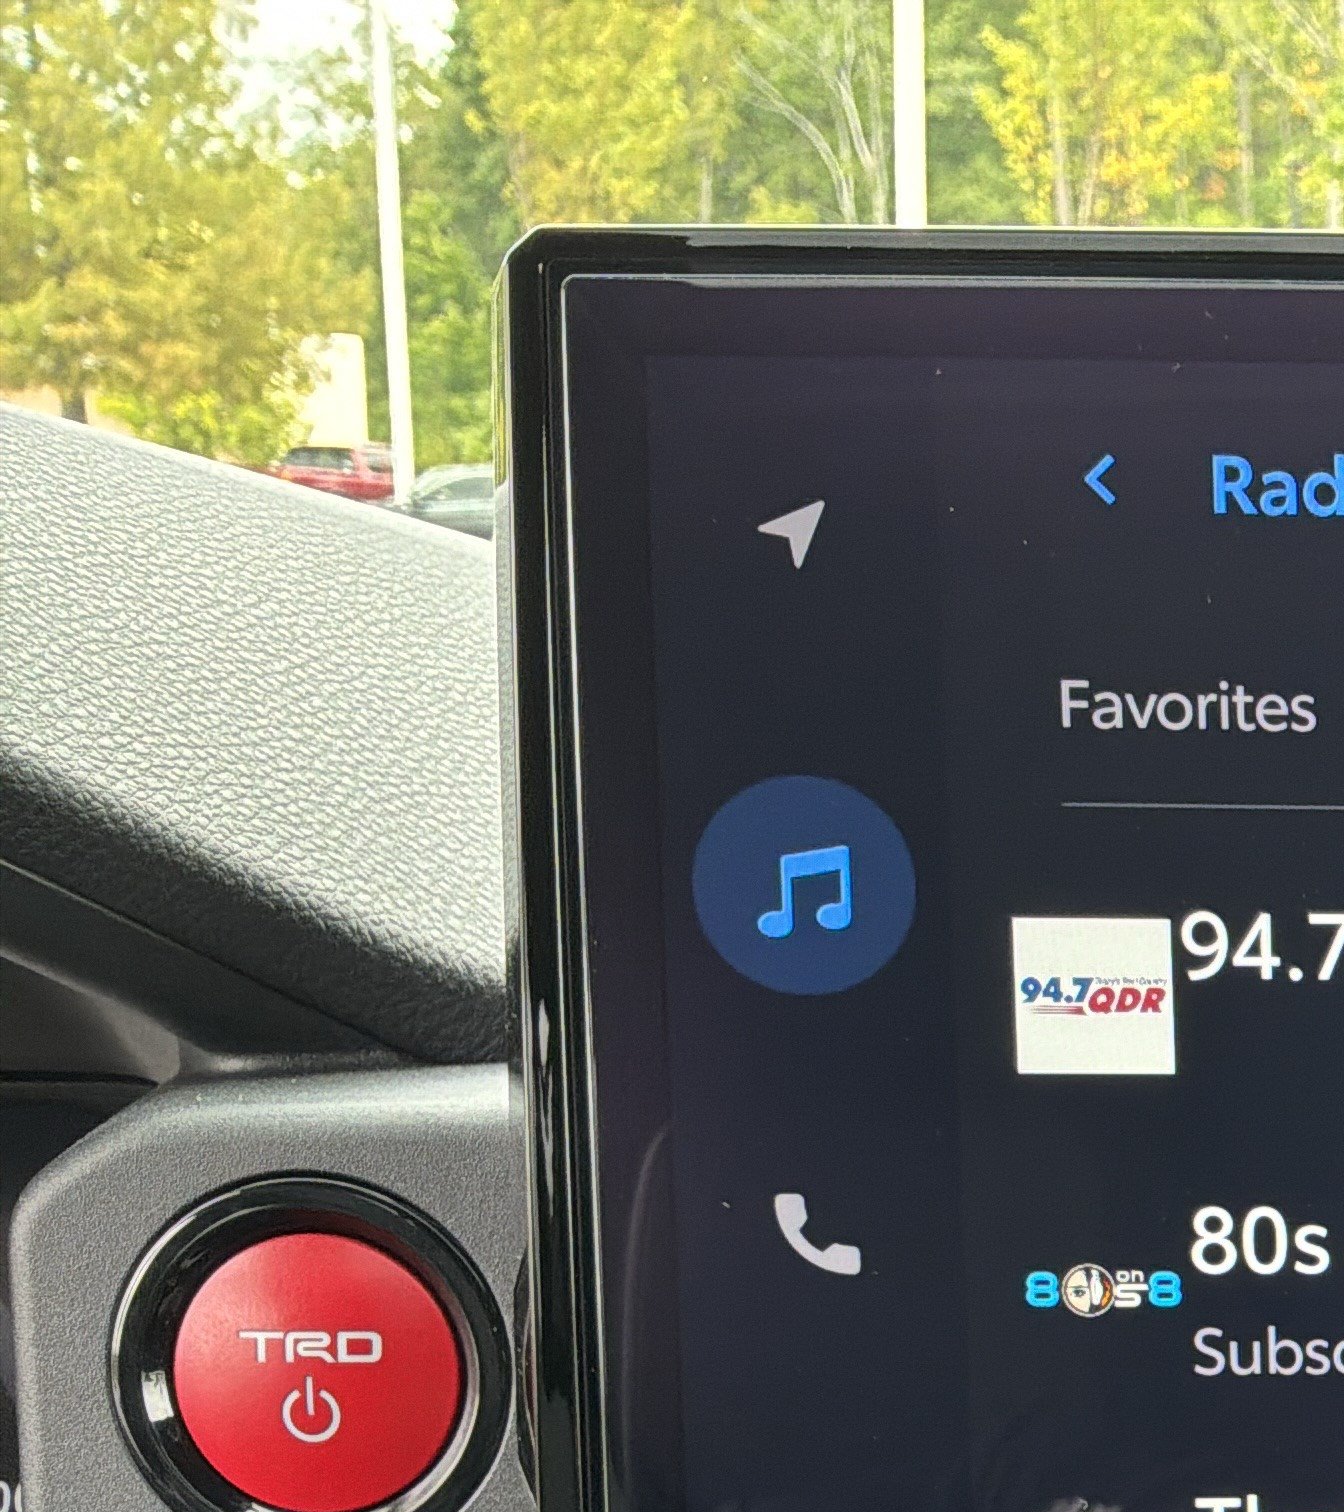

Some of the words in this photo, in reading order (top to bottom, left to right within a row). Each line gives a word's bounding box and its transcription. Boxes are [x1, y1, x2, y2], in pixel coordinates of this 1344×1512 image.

[1060, 679, 1317, 733] Favorites
[1021, 977, 1094, 1003] 94.7
[1089, 987, 1166, 1014] QDR
[1190, 1205, 1330, 1276] 80s
[238, 1330, 383, 1363] TRD
